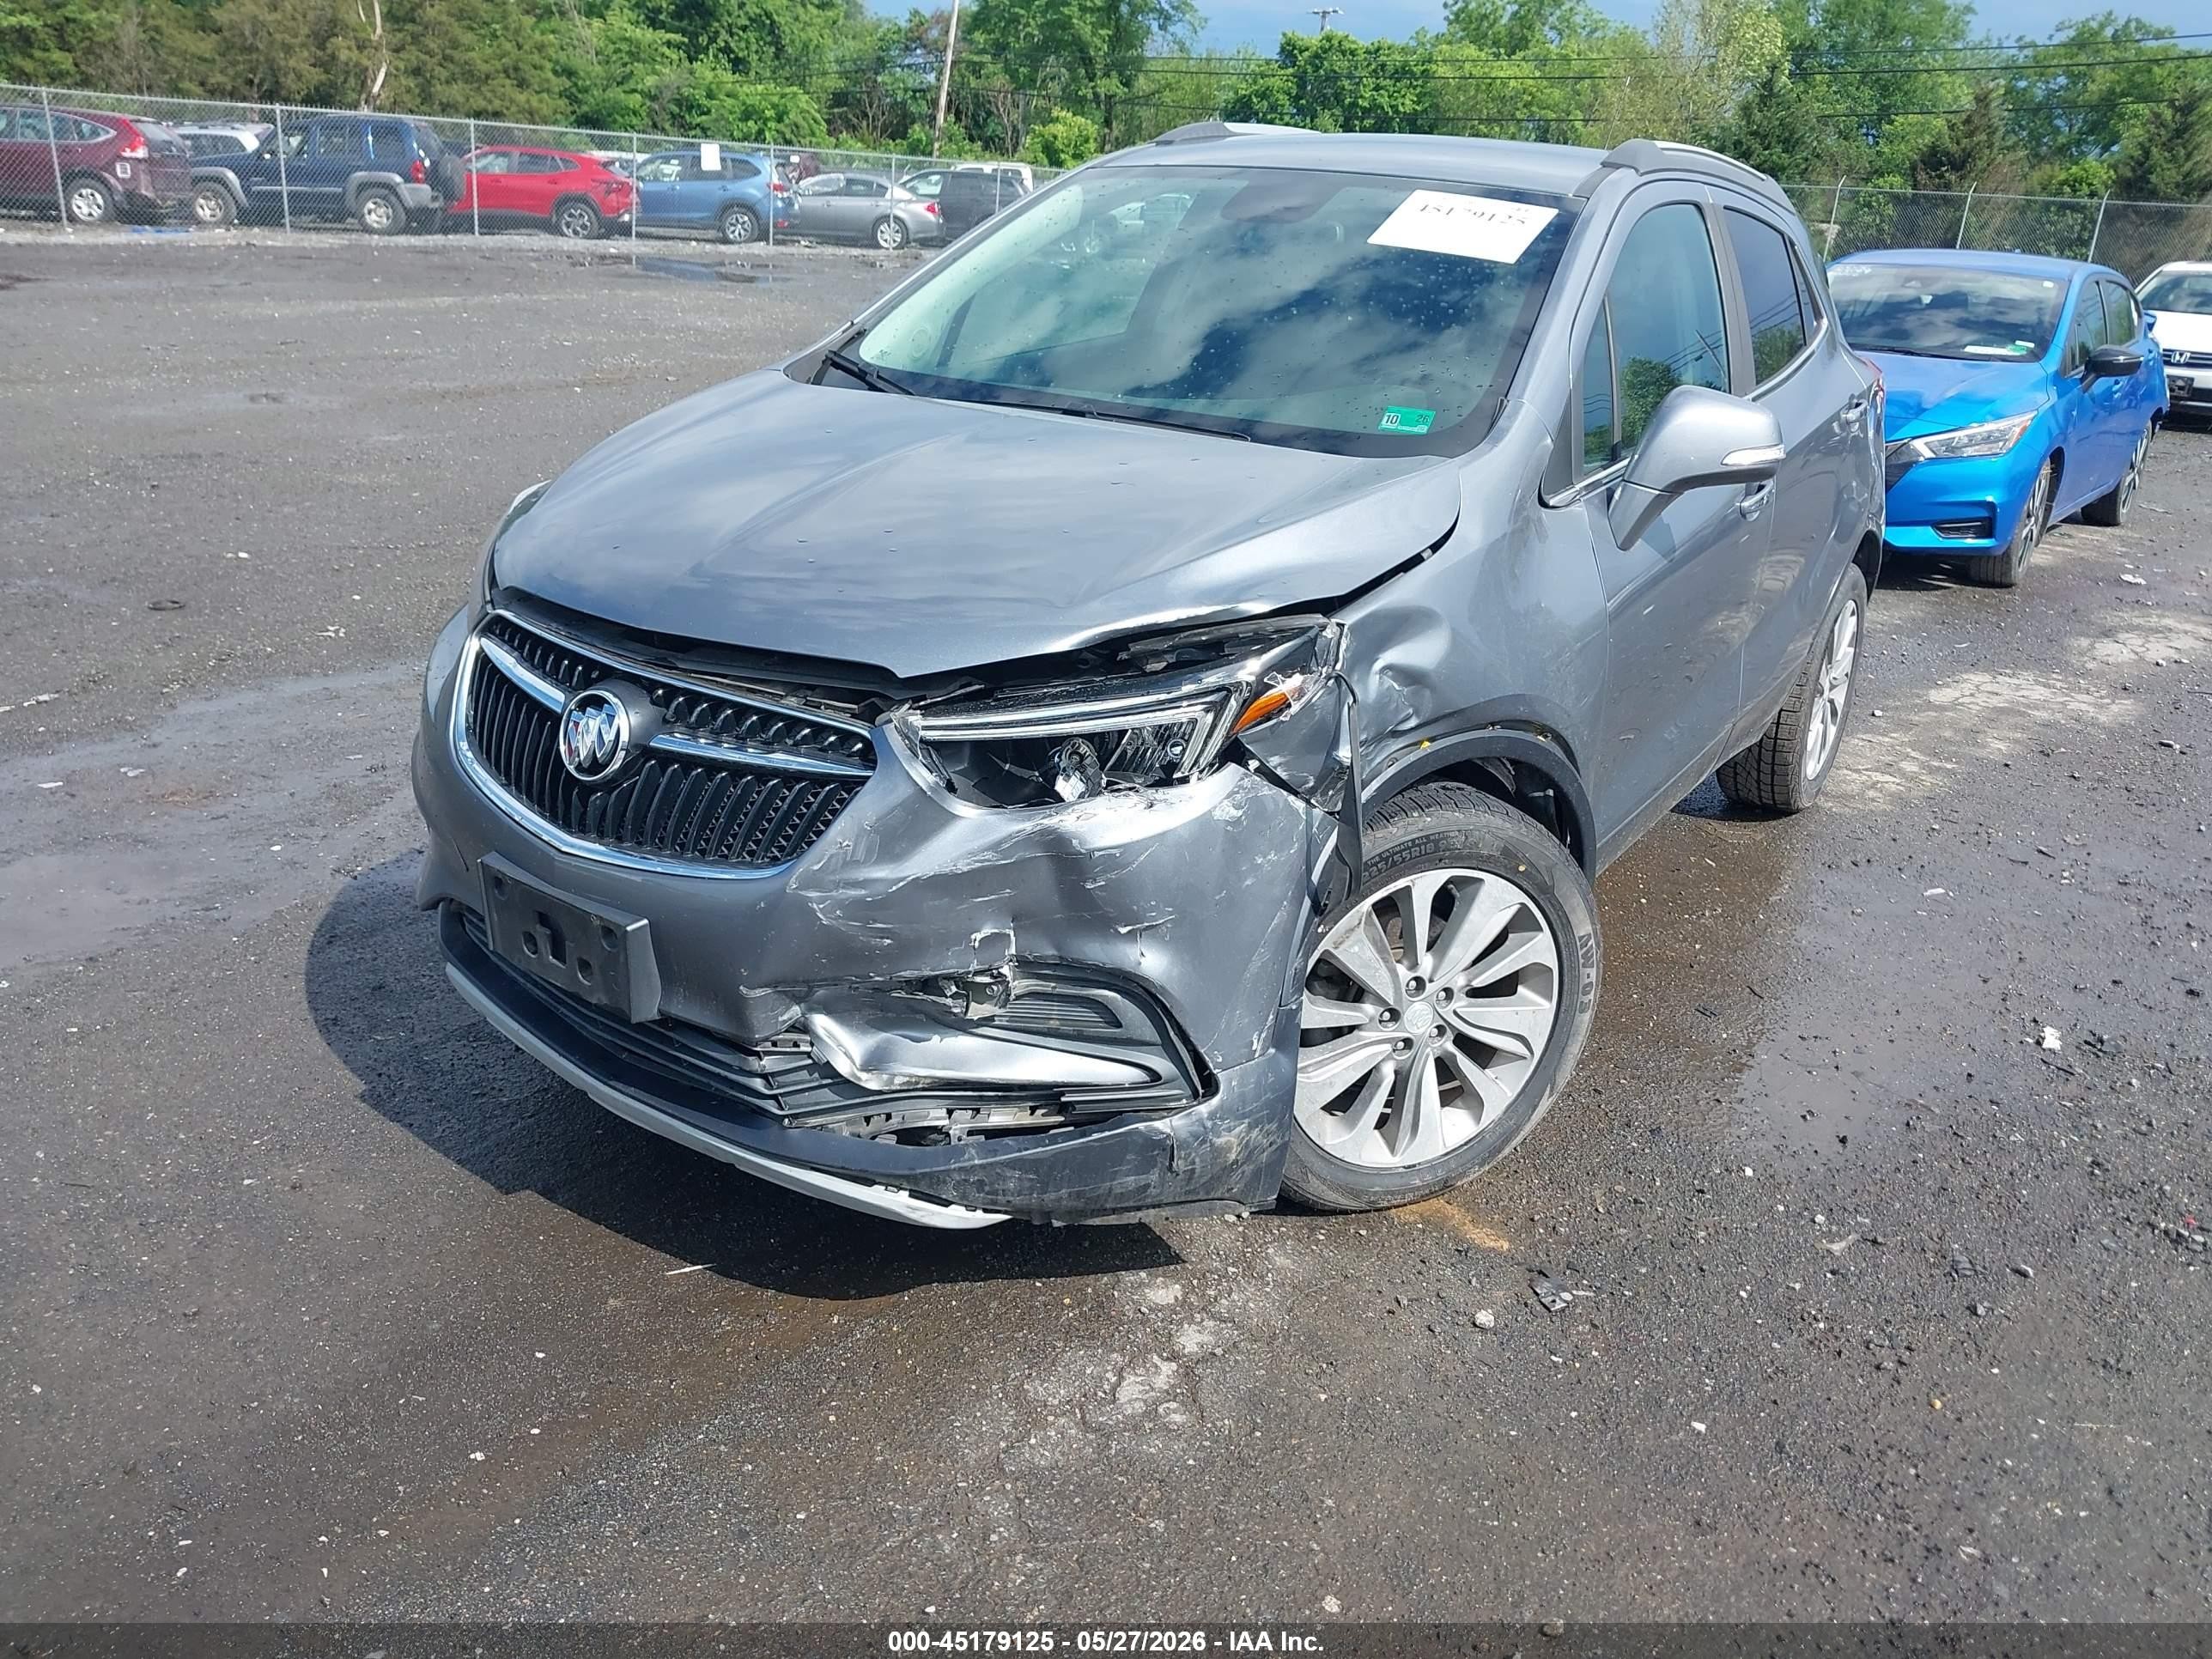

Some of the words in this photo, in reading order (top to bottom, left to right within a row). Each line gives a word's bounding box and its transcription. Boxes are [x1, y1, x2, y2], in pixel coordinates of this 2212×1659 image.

[1385, 414, 1400, 424] 10
[1381, 841, 1413, 858] ULTIMATE
[1414, 836, 1427, 846] ALL
[1429, 830, 1460, 841] WEATHER
